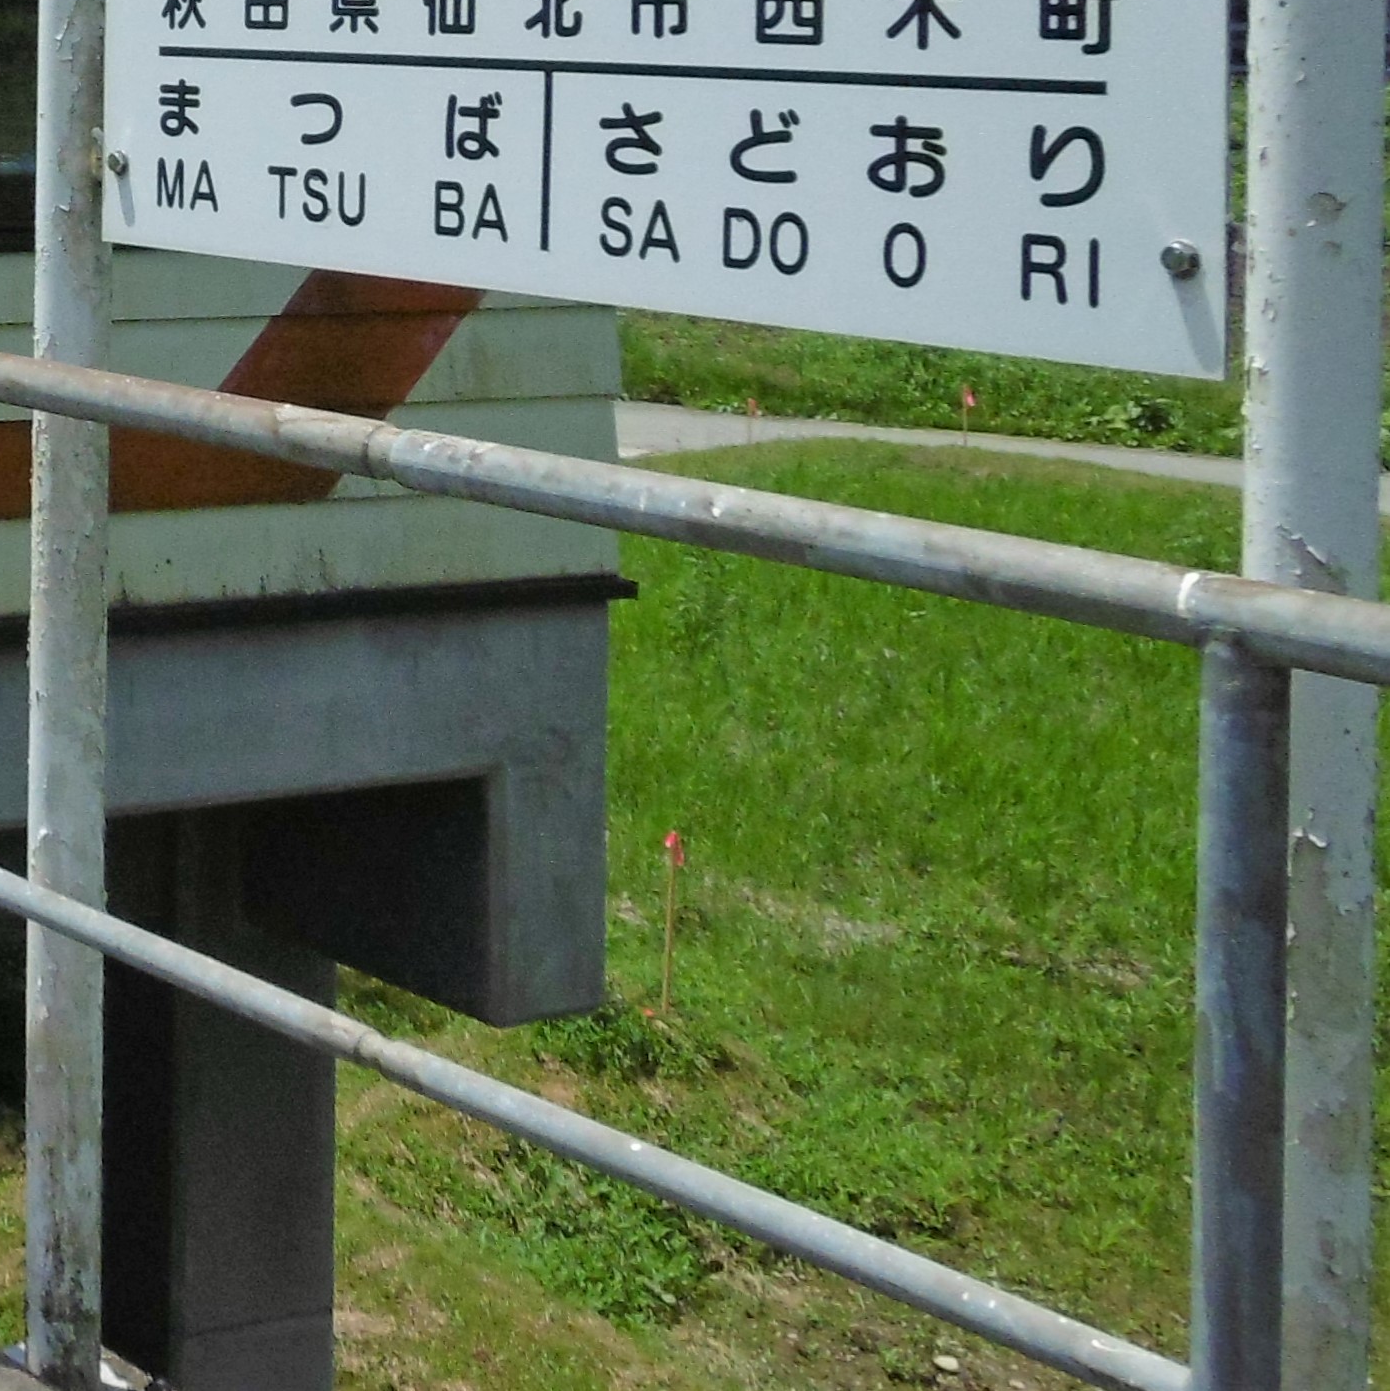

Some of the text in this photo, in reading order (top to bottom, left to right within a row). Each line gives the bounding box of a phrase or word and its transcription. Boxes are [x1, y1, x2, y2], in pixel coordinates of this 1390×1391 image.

[158, 79, 502, 161] まつば
[600, 102, 1106, 207] さどおり
[157, 157, 508, 243] MA TSU BA
[599, 196, 1100, 309] SA DO O RI
